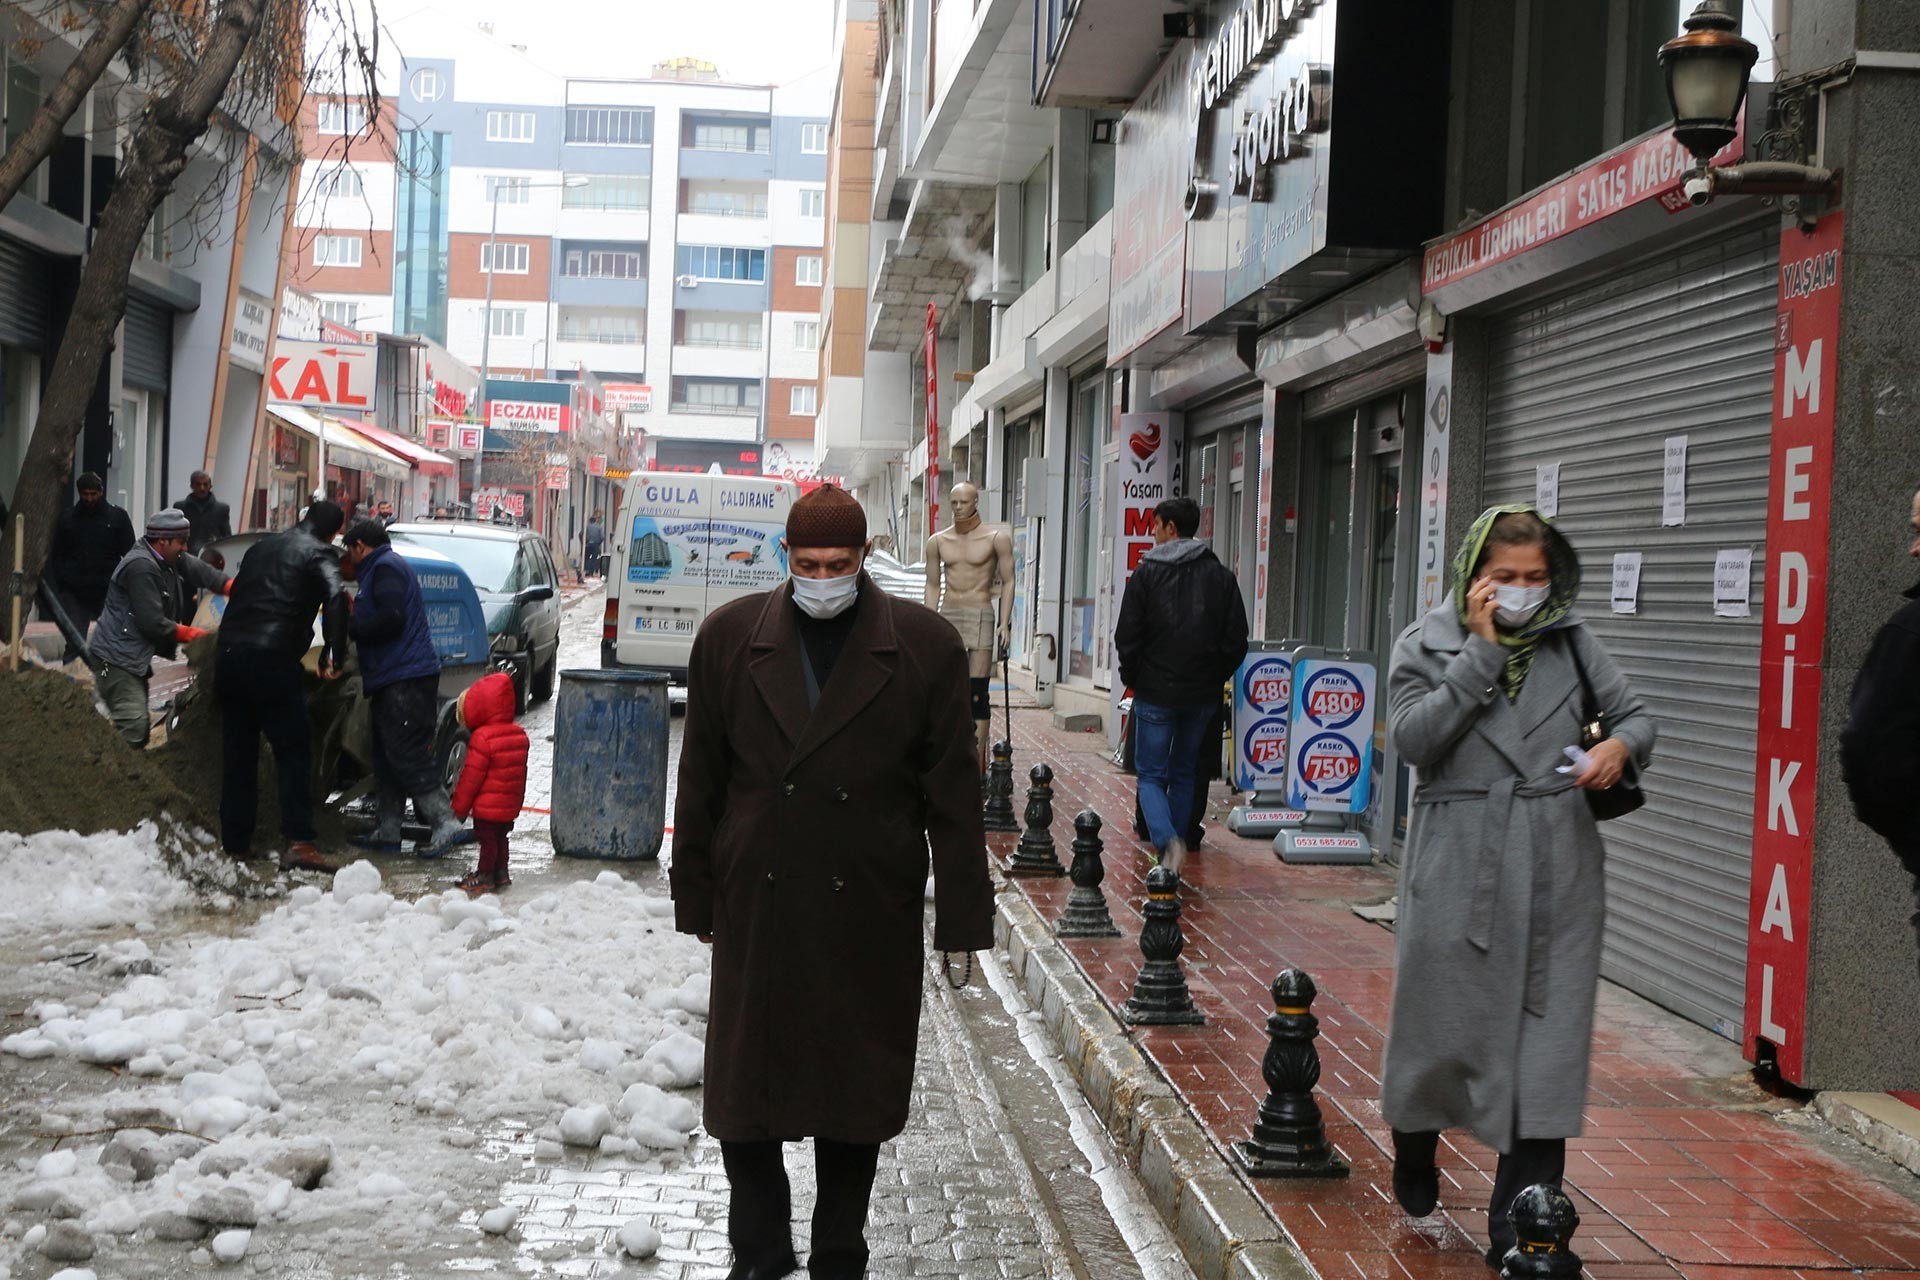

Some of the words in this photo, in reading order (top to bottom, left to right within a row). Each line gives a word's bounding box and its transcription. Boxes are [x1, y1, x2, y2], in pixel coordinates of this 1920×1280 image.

[1229, 62, 1310, 202] sigorta
[1425, 238, 1476, 287] MEDİKAL
[1479, 186, 1567, 264] ÜRÜNLERİ
[1577, 164, 1627, 220] SATIŞ
[1782, 249, 1839, 300] YAŞAM
[493, 403, 558, 421] ECZANE
[646, 486, 699, 504] GULA
[1123, 479, 1163, 500] Yaşam
[658, 620, 669, 630] LC
[1260, 667, 1285, 675] TRAFİK
[1320, 677, 1348, 687] TRAFİK
[1757, 337, 1823, 1046] MEDİKAL
[1260, 726, 1285, 734] KASKO
[1317, 742, 1343, 751] KASKO
